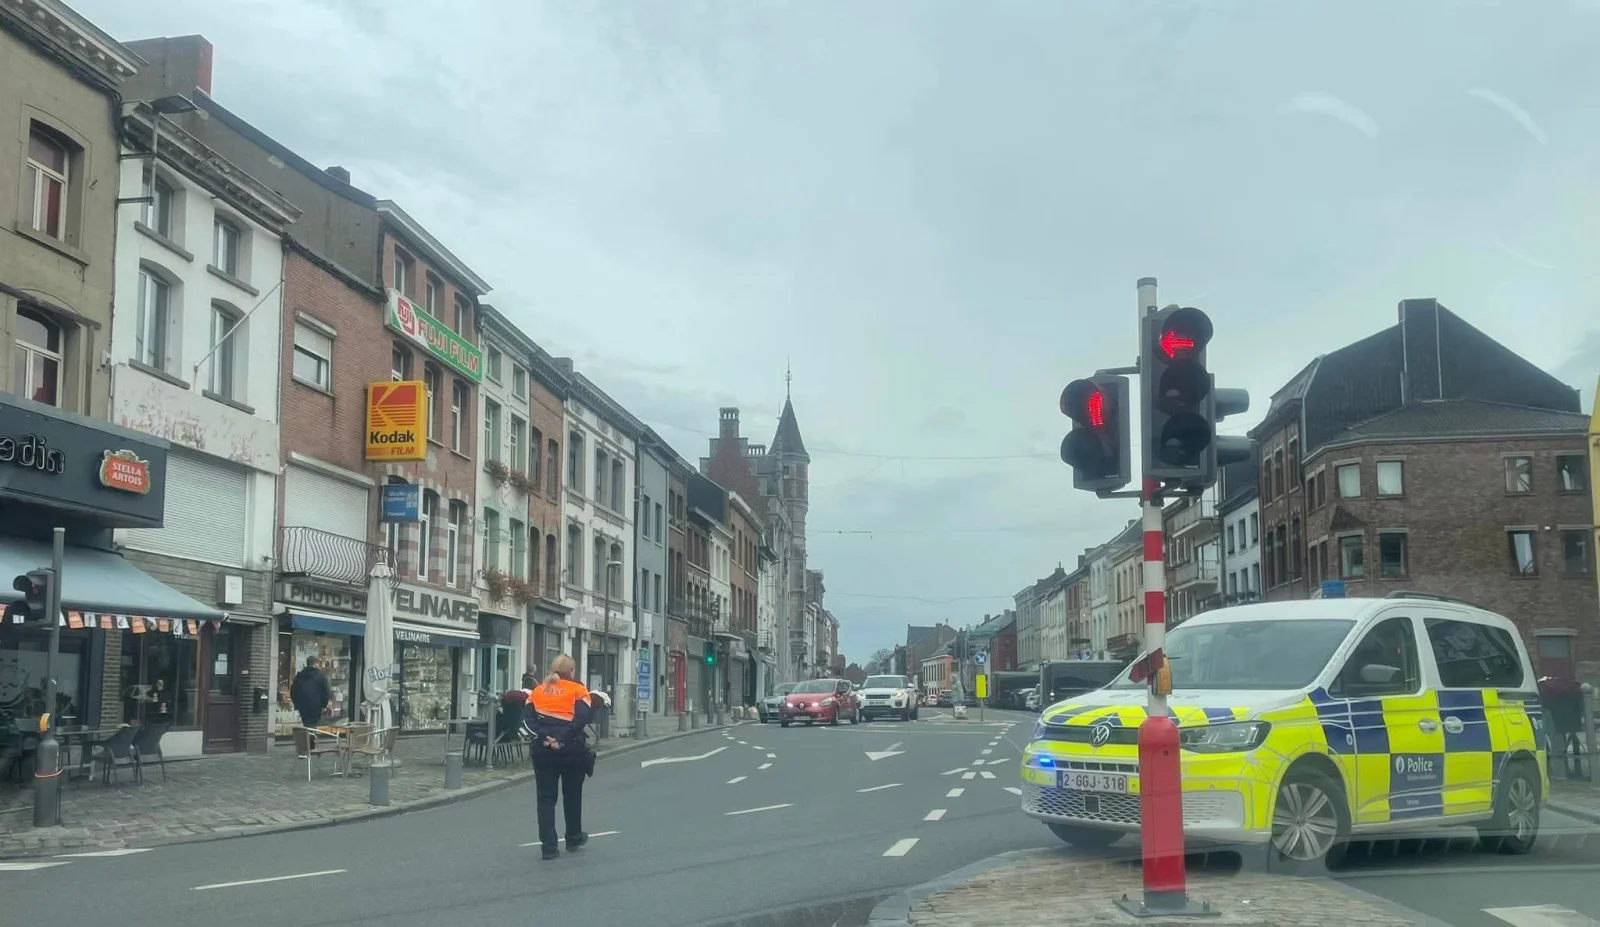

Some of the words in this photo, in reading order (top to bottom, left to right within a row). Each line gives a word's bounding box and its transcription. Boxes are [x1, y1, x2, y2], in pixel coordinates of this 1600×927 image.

[417, 317, 448, 354] FUJI
[449, 339, 479, 375] FILM
[370, 430, 415, 444] Kodak
[391, 446, 415, 456] FILM
[112, 462, 142, 476] STELLA
[112, 473, 142, 486] ARTOIS
[396, 630, 430, 643] VELINAIRE
[1407, 756, 1434, 772] Police
[1064, 774, 1125, 792] 2-GGJ-318
